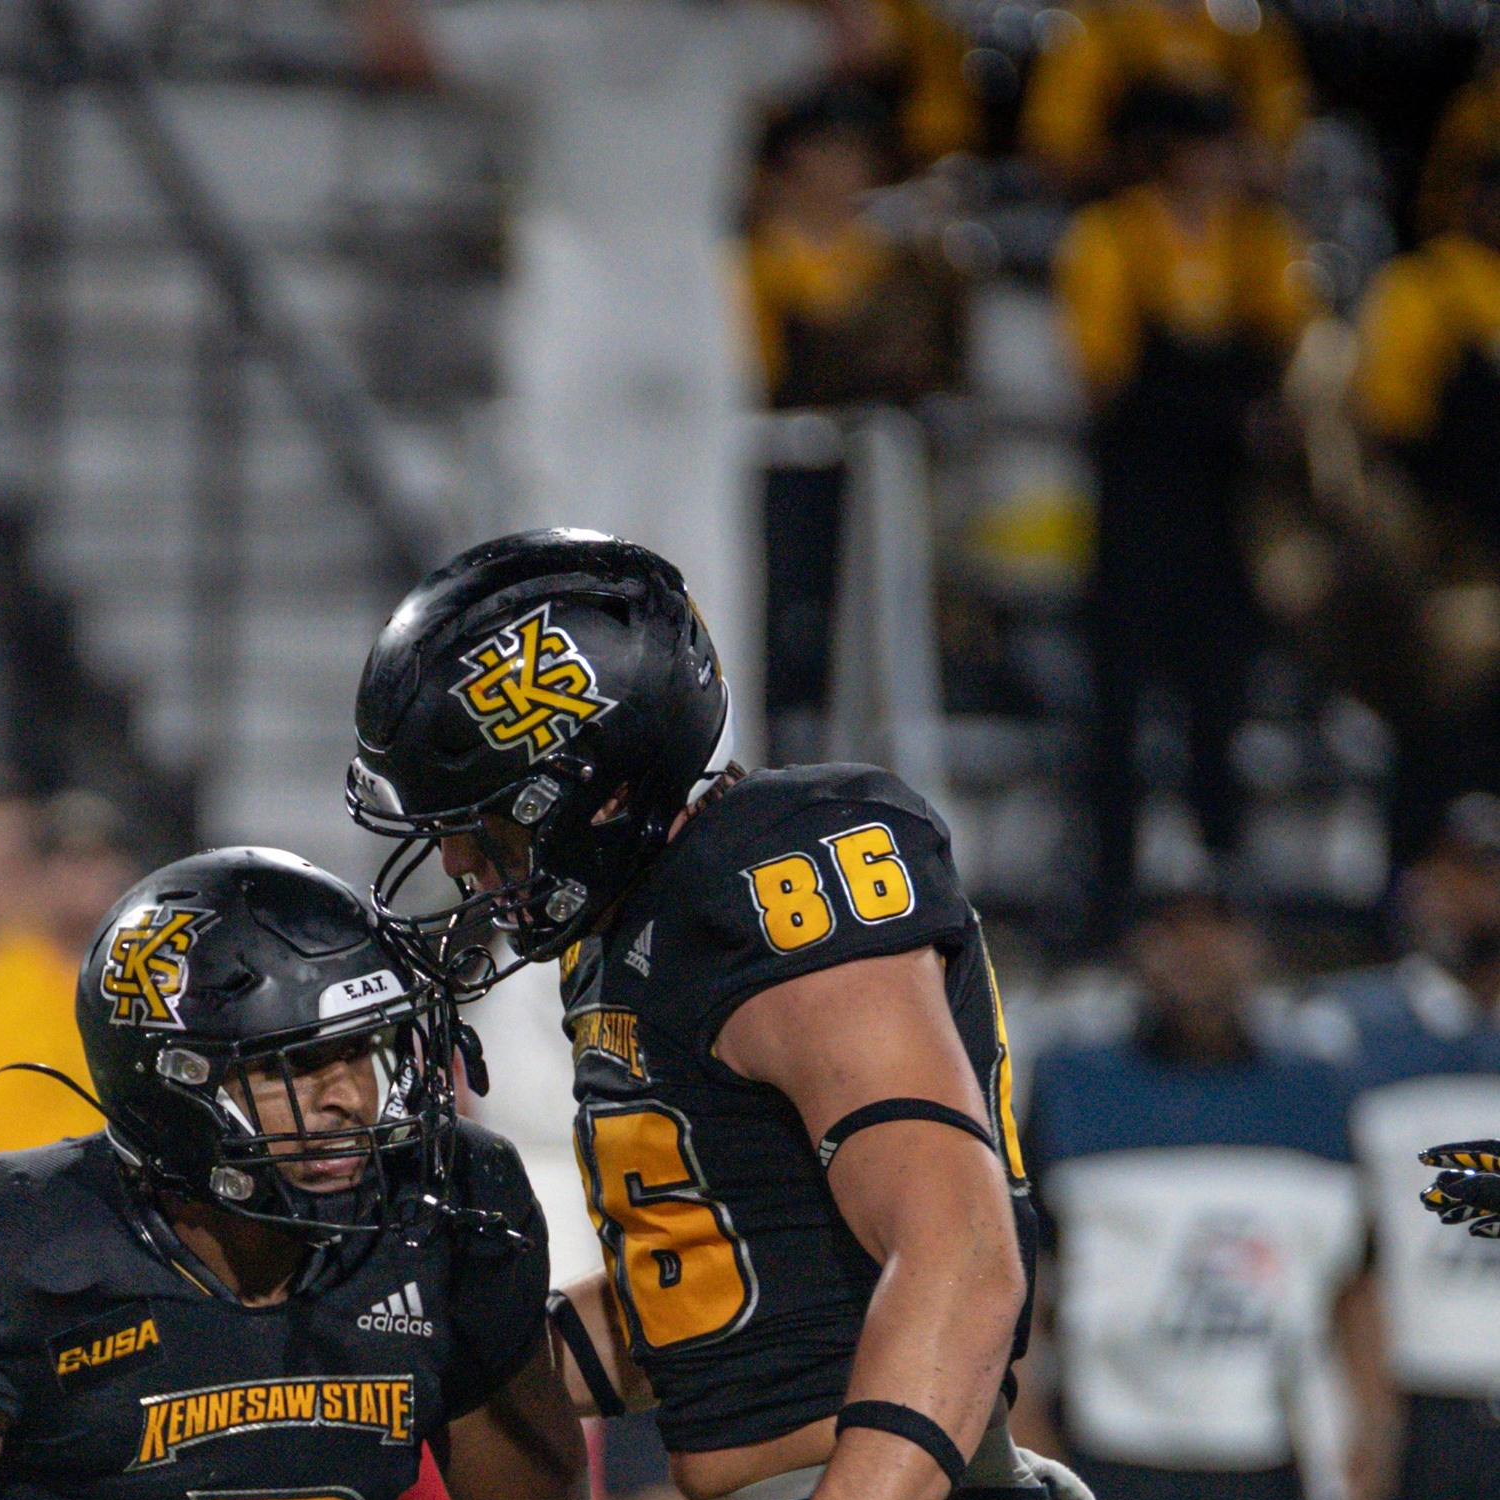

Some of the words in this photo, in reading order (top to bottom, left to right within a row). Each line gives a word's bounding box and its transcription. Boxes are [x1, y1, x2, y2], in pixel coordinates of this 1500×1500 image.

[738, 822, 915, 956] 86
[343, 975, 388, 1000] E.A.T.
[573, 1100, 759, 1356] 6
[357, 1312, 433, 1338] adidas
[136, 1382, 317, 1464] KENNESAW
[321, 1381, 411, 1440] STATE
